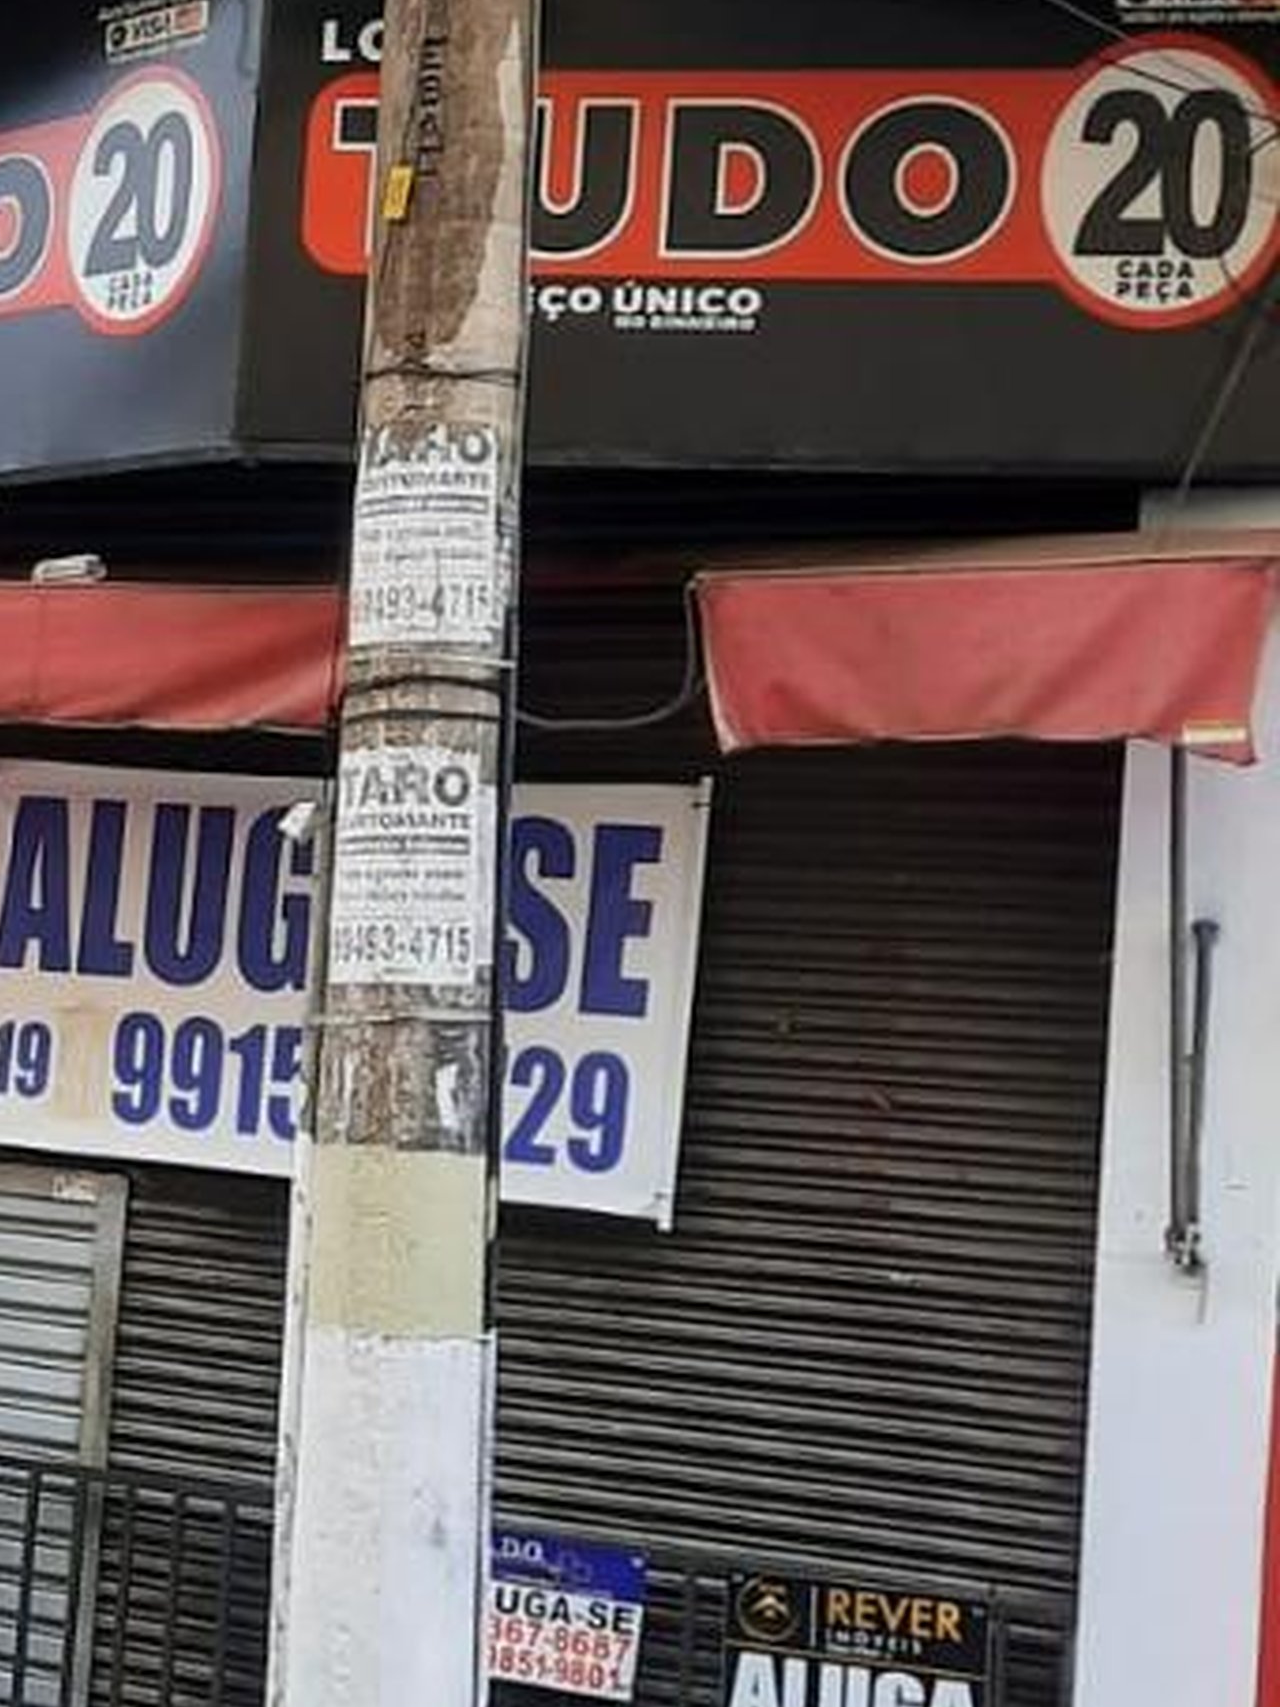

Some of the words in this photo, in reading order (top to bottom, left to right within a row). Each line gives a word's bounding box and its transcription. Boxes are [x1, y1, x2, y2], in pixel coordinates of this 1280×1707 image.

[320, 20, 383, 63] LO
[85, 110, 194, 278] 20
[1072, 88, 1253, 260] 20
[1115, 259, 1194, 279] CADA
[1115, 280, 1194, 304] PEÇA
[613, 279, 762, 315] ÚNICO
[495, 1586, 637, 1636] UGA-SE
[826, 1587, 962, 1644] REVER
